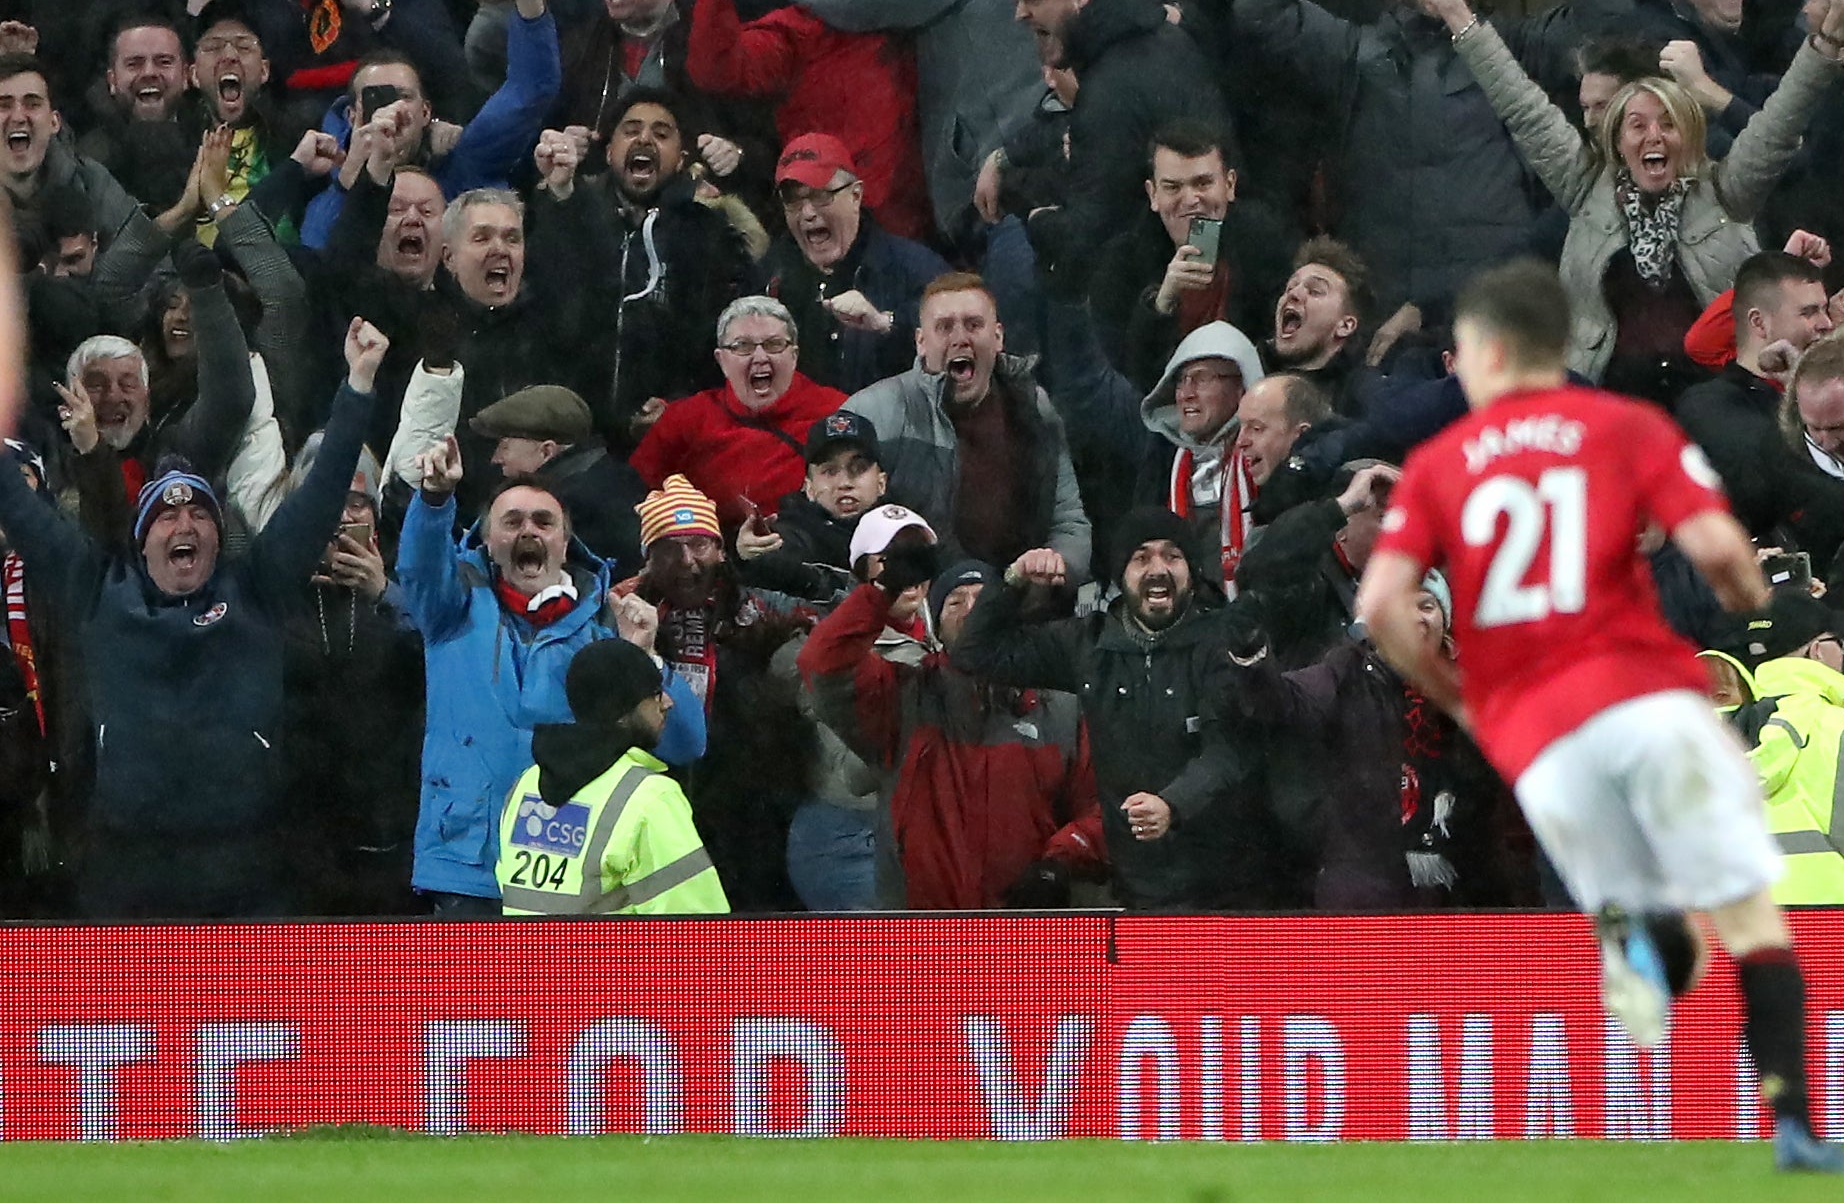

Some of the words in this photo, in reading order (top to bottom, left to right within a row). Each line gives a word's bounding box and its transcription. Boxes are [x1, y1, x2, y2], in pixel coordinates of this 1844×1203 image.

[1461, 466, 1588, 630] 21
[546, 821, 586, 847] CSG
[510, 850, 569, 890] 204
